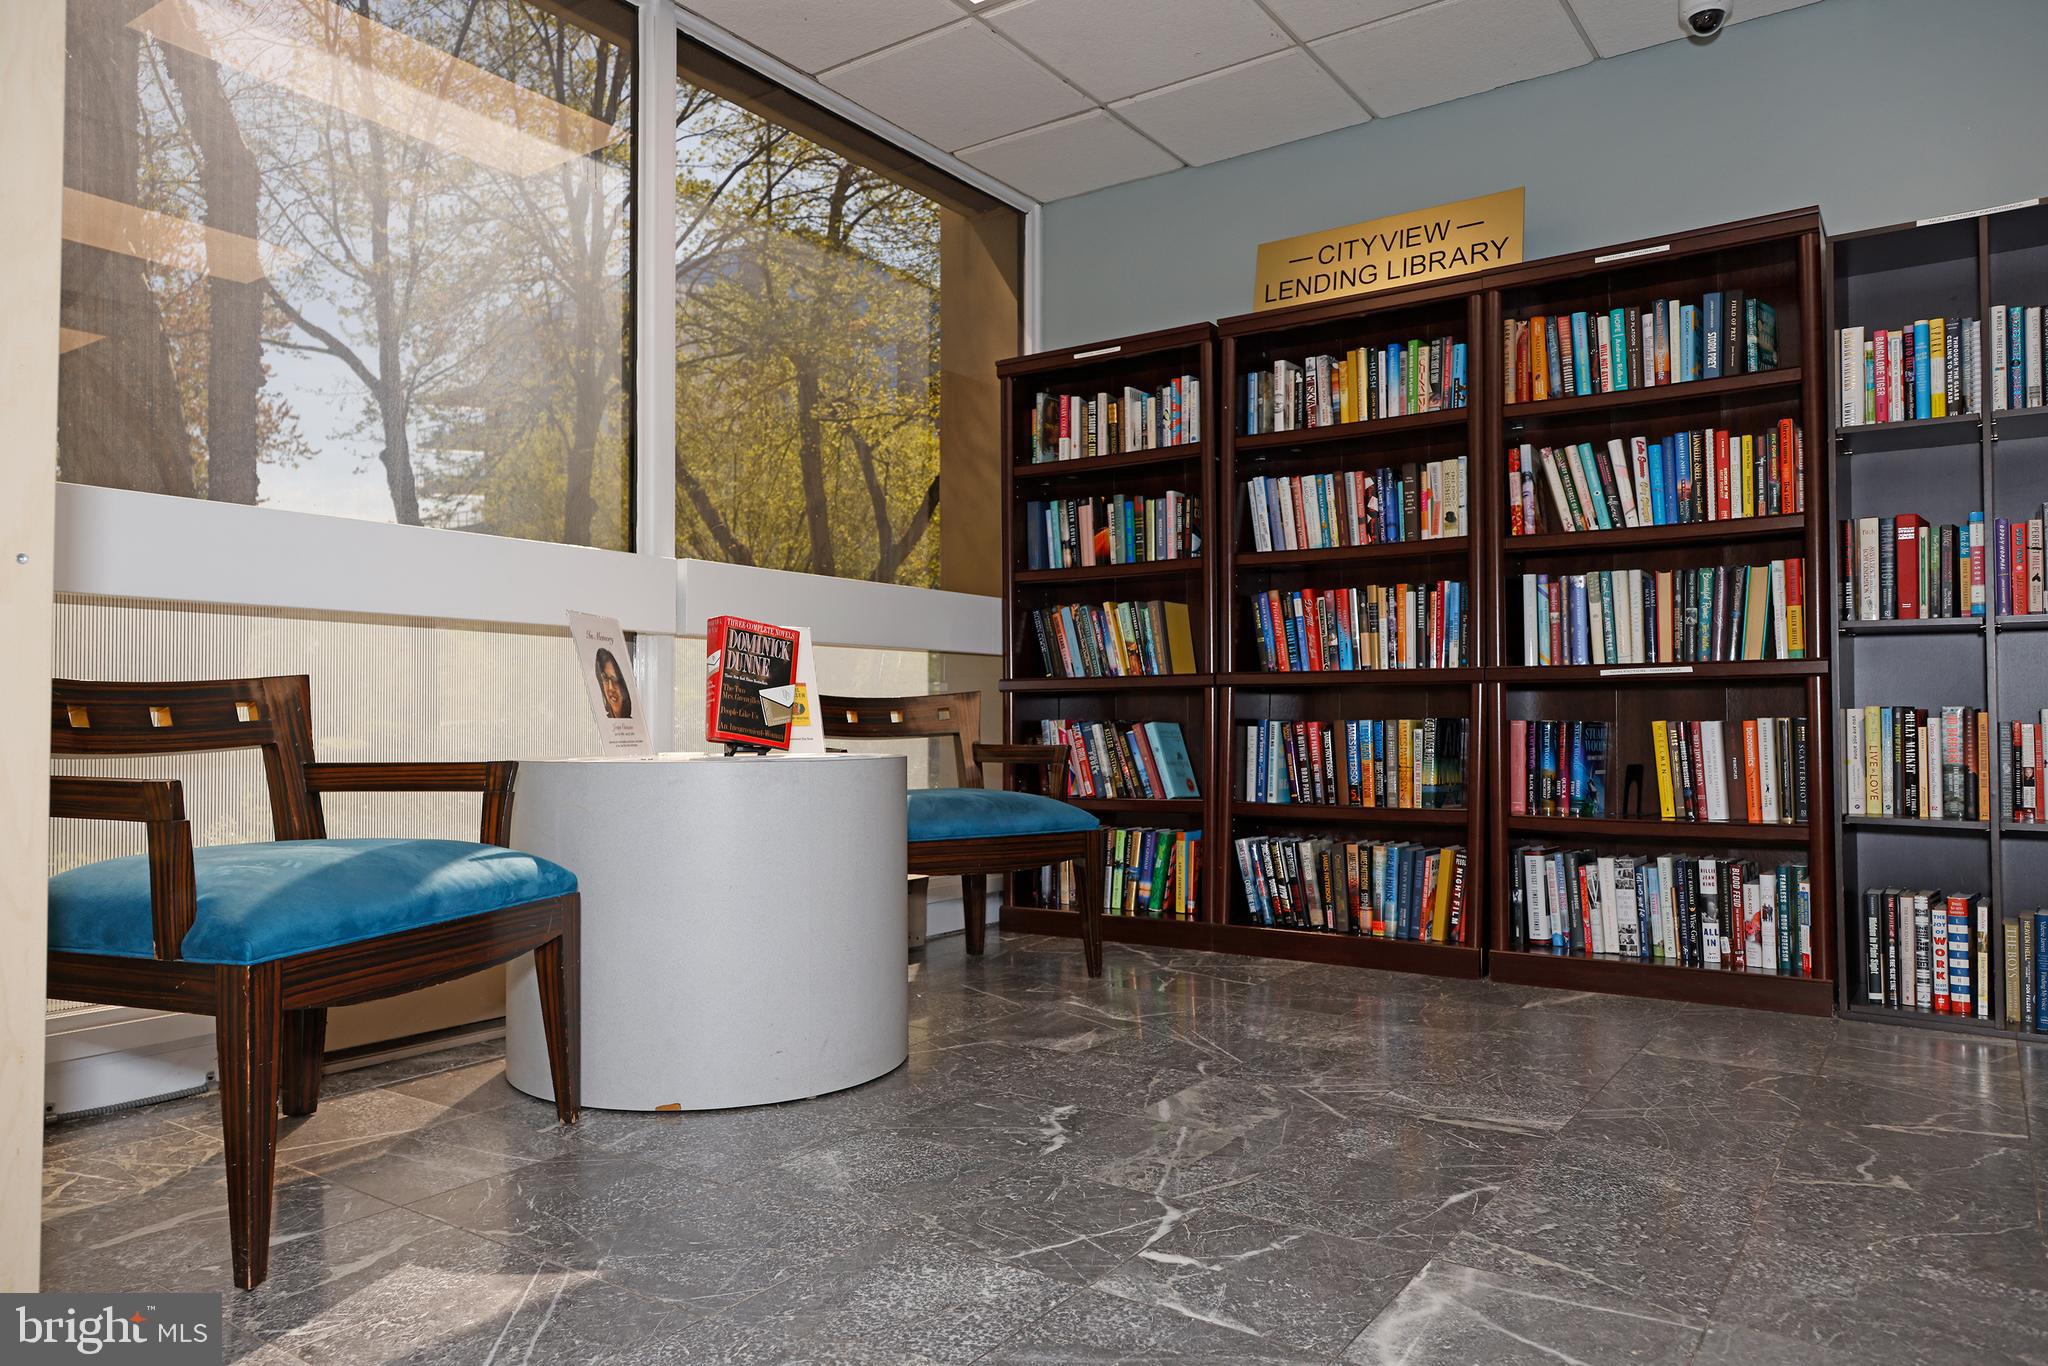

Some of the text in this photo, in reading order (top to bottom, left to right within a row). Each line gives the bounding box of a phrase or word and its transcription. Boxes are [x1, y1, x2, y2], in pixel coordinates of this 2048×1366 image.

[1318, 220, 1451, 265] CITYVIEW
[1264, 237, 1509, 303] LENDING LIBRARY
[1731, 318, 1736, 326] OF
[1708, 332, 1716, 368] STORM PREY
[1876, 336, 1886, 396] BANGALORE TIGER
[1882, 524, 1894, 586] DRAMA HIGH
[1702, 573, 1712, 600] Beautiful
[596, 632, 614, 646] Memory
[727, 618, 746, 628] THREE
[746, 621, 774, 635] COMPLETE
[775, 628, 795, 640] NOVELS
[728, 628, 790, 660] DOMINICK
[726, 650, 771, 677] DUNNE
[719, 722, 728, 730] An
[720, 706, 759, 720] People Like Us
[1104, 728, 1114, 748] KILLER
[1298, 736, 1306, 761] NOTHING
[1904, 712, 1916, 774] BULLY MARKET
[1347, 722, 1358, 786] JAMES PATTERSON
[1798, 744, 1806, 804] SCATTERSHOT
[1870, 746, 1879, 800] LIVE LOVE
[1452, 868, 1463, 924] NIGHT FILM
[1733, 890, 1741, 908] FEUD
[1690, 930, 1698, 944] Guy
[1869, 917, 1878, 936] Hidden
[1870, 944, 1878, 958] Plain
[1933, 936, 1946, 980] WORK
[2006, 928, 2018, 978] THE BOYS
[1870, 958, 1879, 974] Sight
